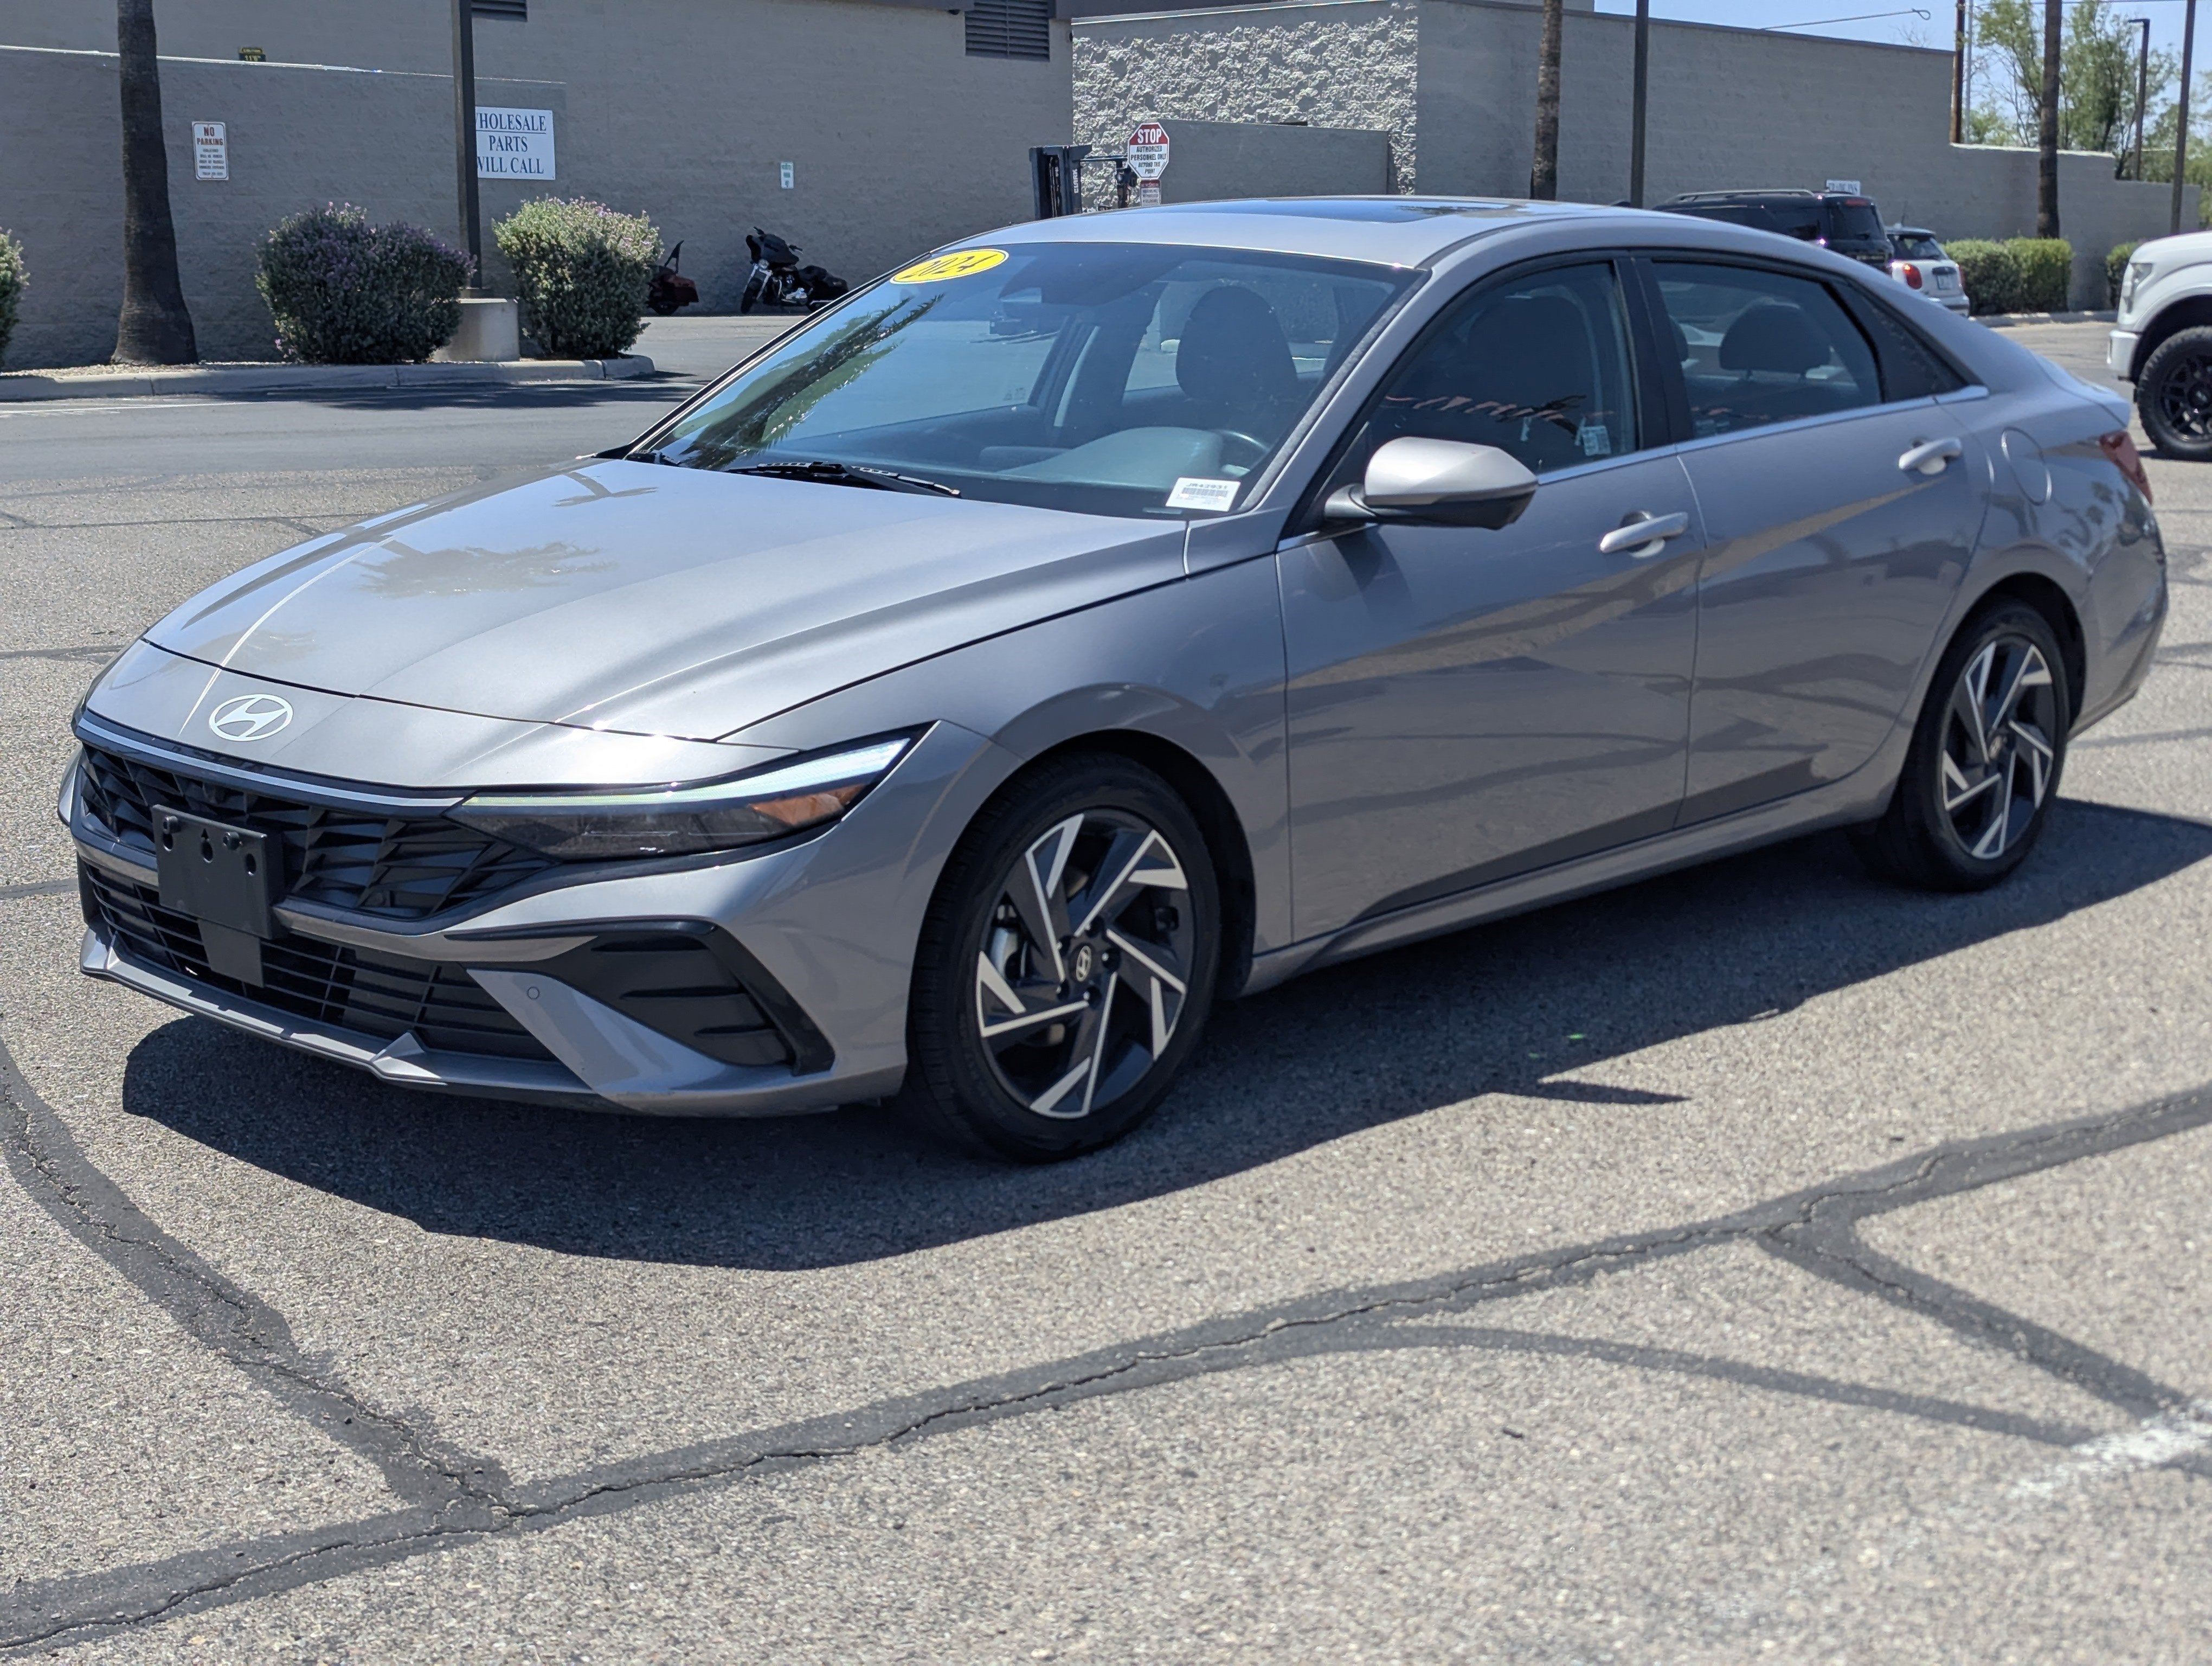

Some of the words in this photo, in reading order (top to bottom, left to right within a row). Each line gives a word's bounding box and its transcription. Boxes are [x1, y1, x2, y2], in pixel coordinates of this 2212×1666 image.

[475, 112, 546, 131] HOLESALE
[203, 126, 215, 137] NO
[1137, 128, 1162, 144] STOP
[196, 138, 223, 146] PARKING
[488, 135, 528, 152] PARTS
[510, 157, 544, 174] CALL
[898, 254, 998, 280] 2024
